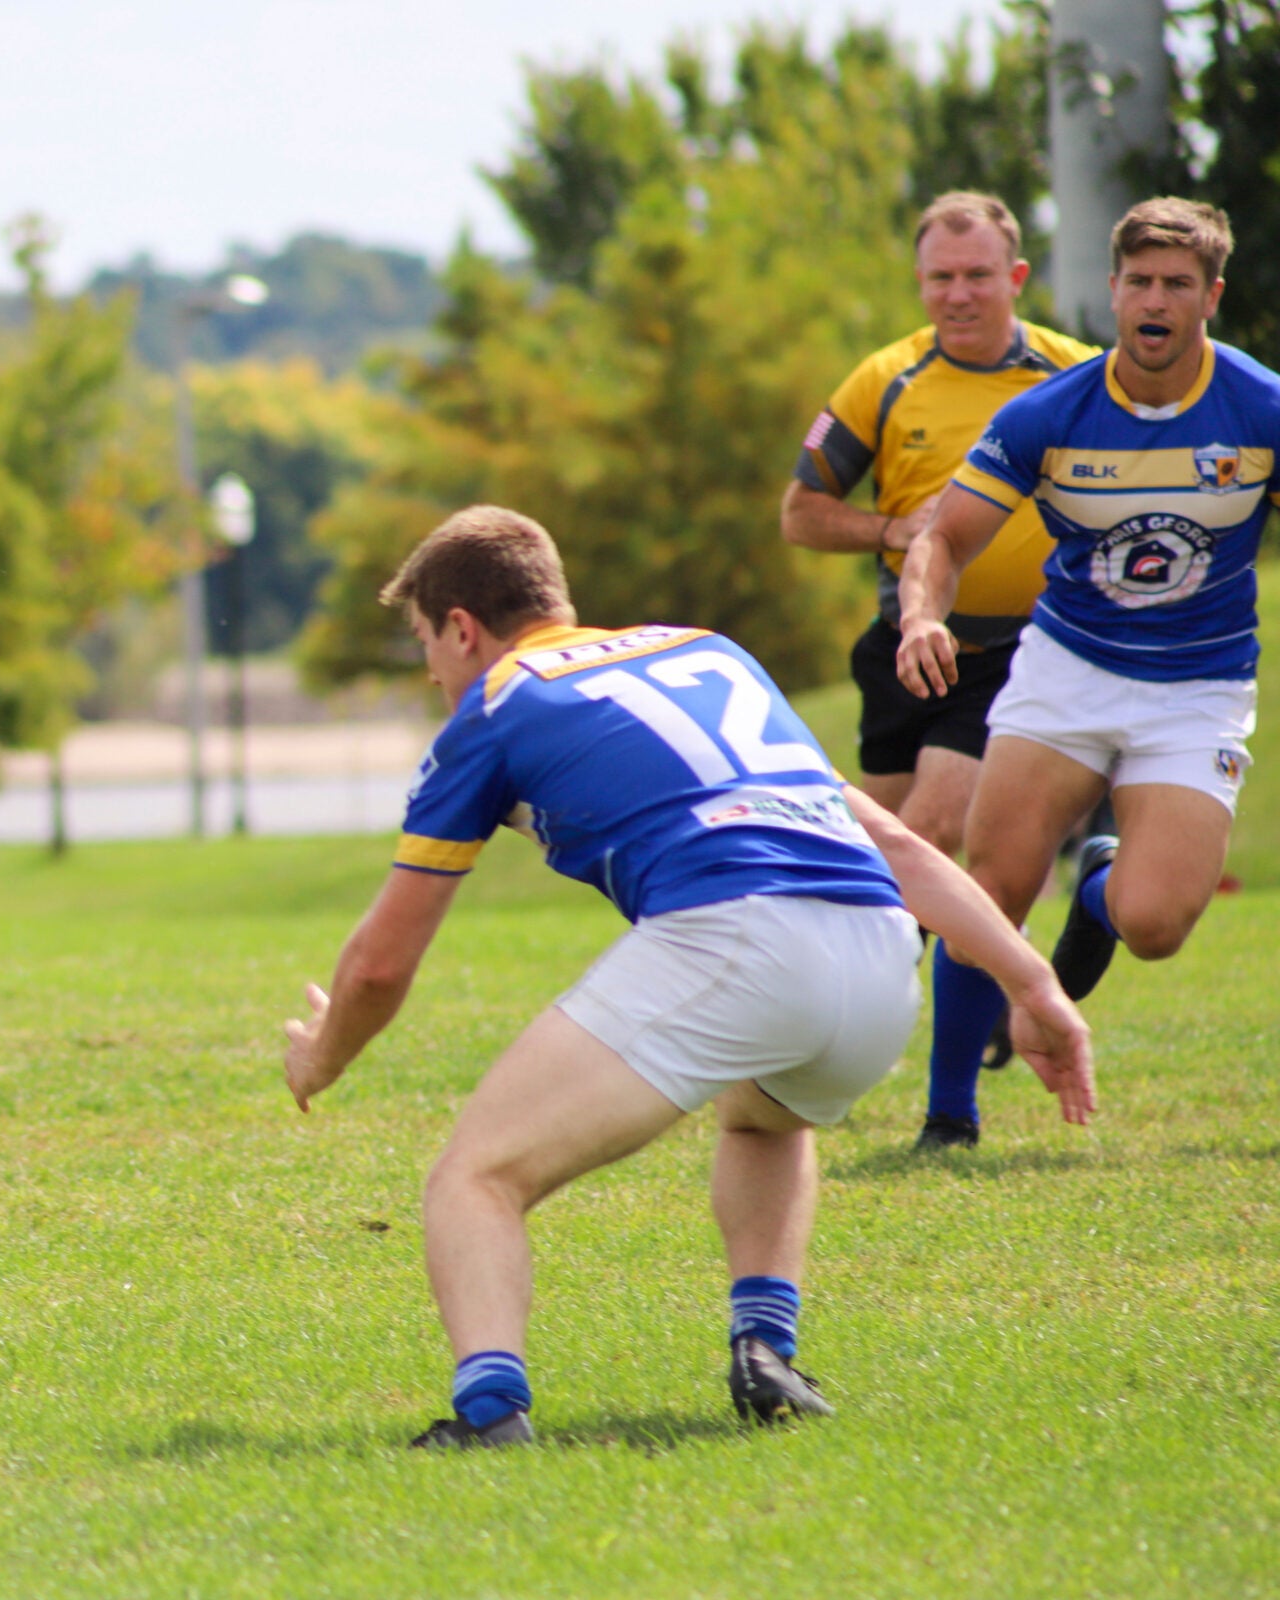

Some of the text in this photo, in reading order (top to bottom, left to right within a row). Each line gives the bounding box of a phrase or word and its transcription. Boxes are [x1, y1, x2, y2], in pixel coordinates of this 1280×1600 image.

[1071, 463, 1119, 478] BLK
[1148, 515, 1211, 548] GEORG
[572, 650, 832, 787] 12
